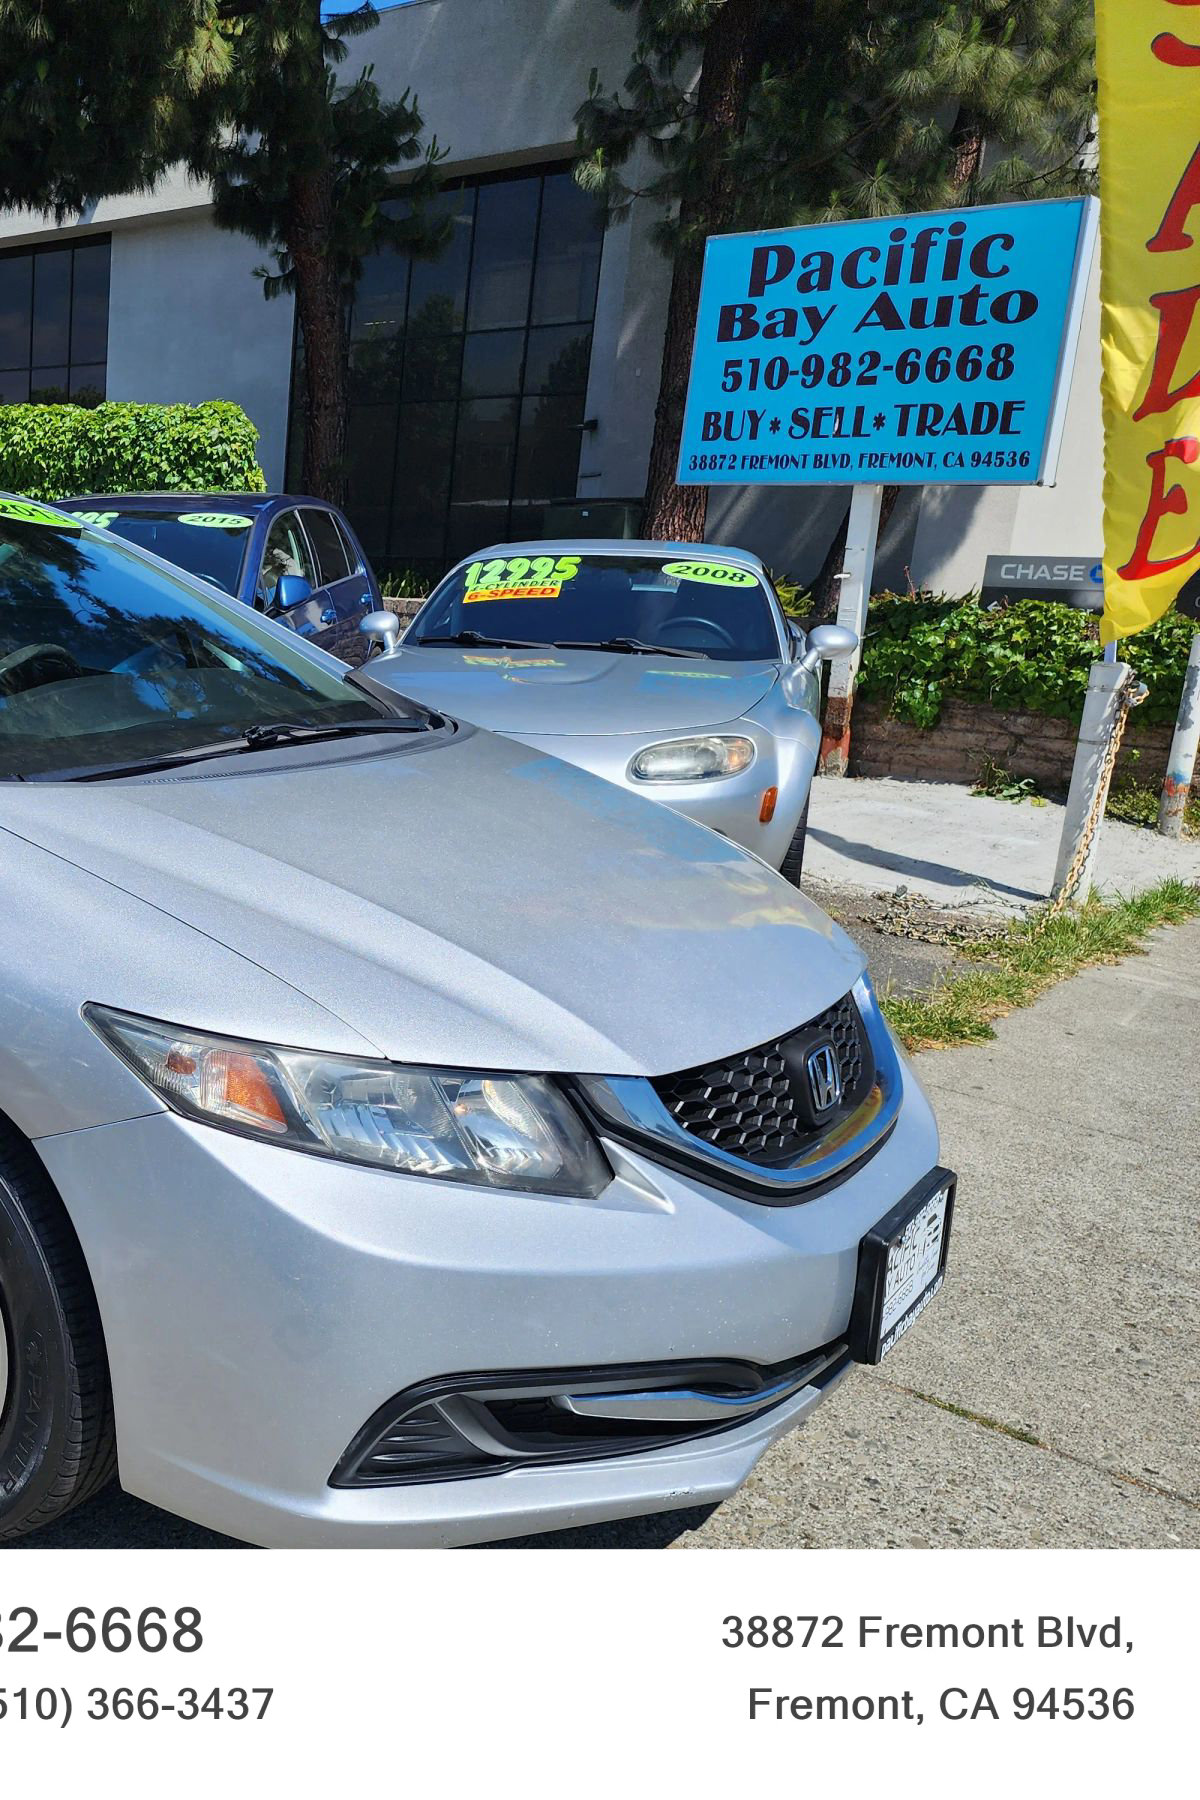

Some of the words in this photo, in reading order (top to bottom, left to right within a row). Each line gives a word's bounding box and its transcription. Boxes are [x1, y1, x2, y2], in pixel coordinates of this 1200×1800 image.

[748, 221, 1015, 298] Pacific
[717, 303, 838, 346] Bay
[853, 284, 1039, 334] Auto
[721, 343, 1015, 393] 510-982-6668
[701, 409, 767, 442] BUY
[788, 406, 871, 440] SELL
[894, 401, 1026, 437] TRADE
[688, 454, 738, 471] 38872
[741, 453, 809, 470] FREMONT
[813, 453, 854, 471] BLVD,
[858, 452, 938, 470] FREMONT,
[943, 451, 965, 468] CA
[970, 450, 1031, 468] 94536
[190, 515, 243, 525] 2015
[465, 557, 582, 586] 12995
[674, 564, 748, 584] 2008
[1000, 563, 1086, 581] CHASE
[468, 587, 556, 601] 6-SPEED
